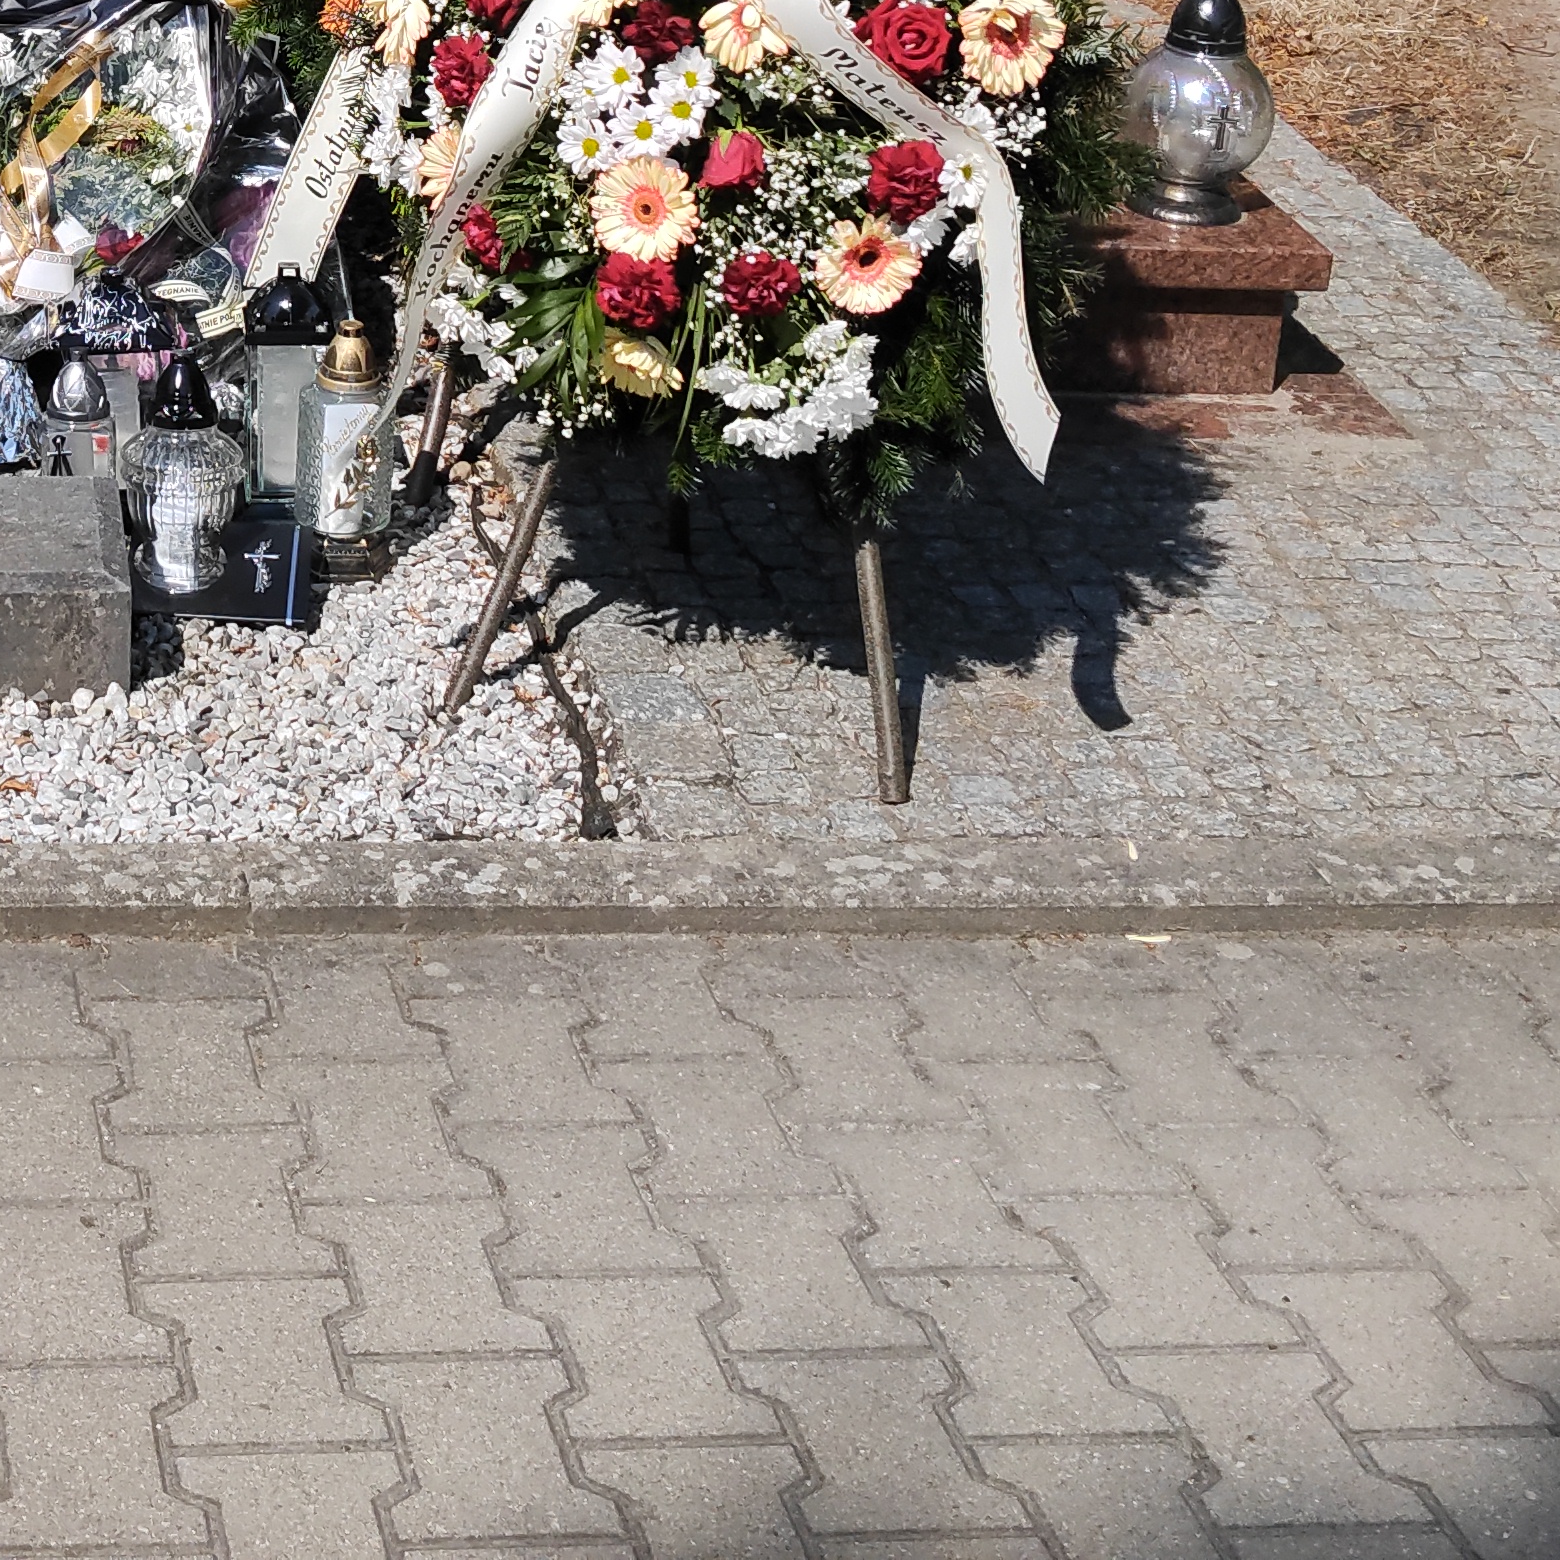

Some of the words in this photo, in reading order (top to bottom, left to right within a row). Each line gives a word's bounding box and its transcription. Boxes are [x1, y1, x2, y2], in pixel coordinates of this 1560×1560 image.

[819, 47, 948, 146] Mateusz
[305, 107, 362, 198] Ostatnie
[414, 151, 504, 302] Kochanemu
